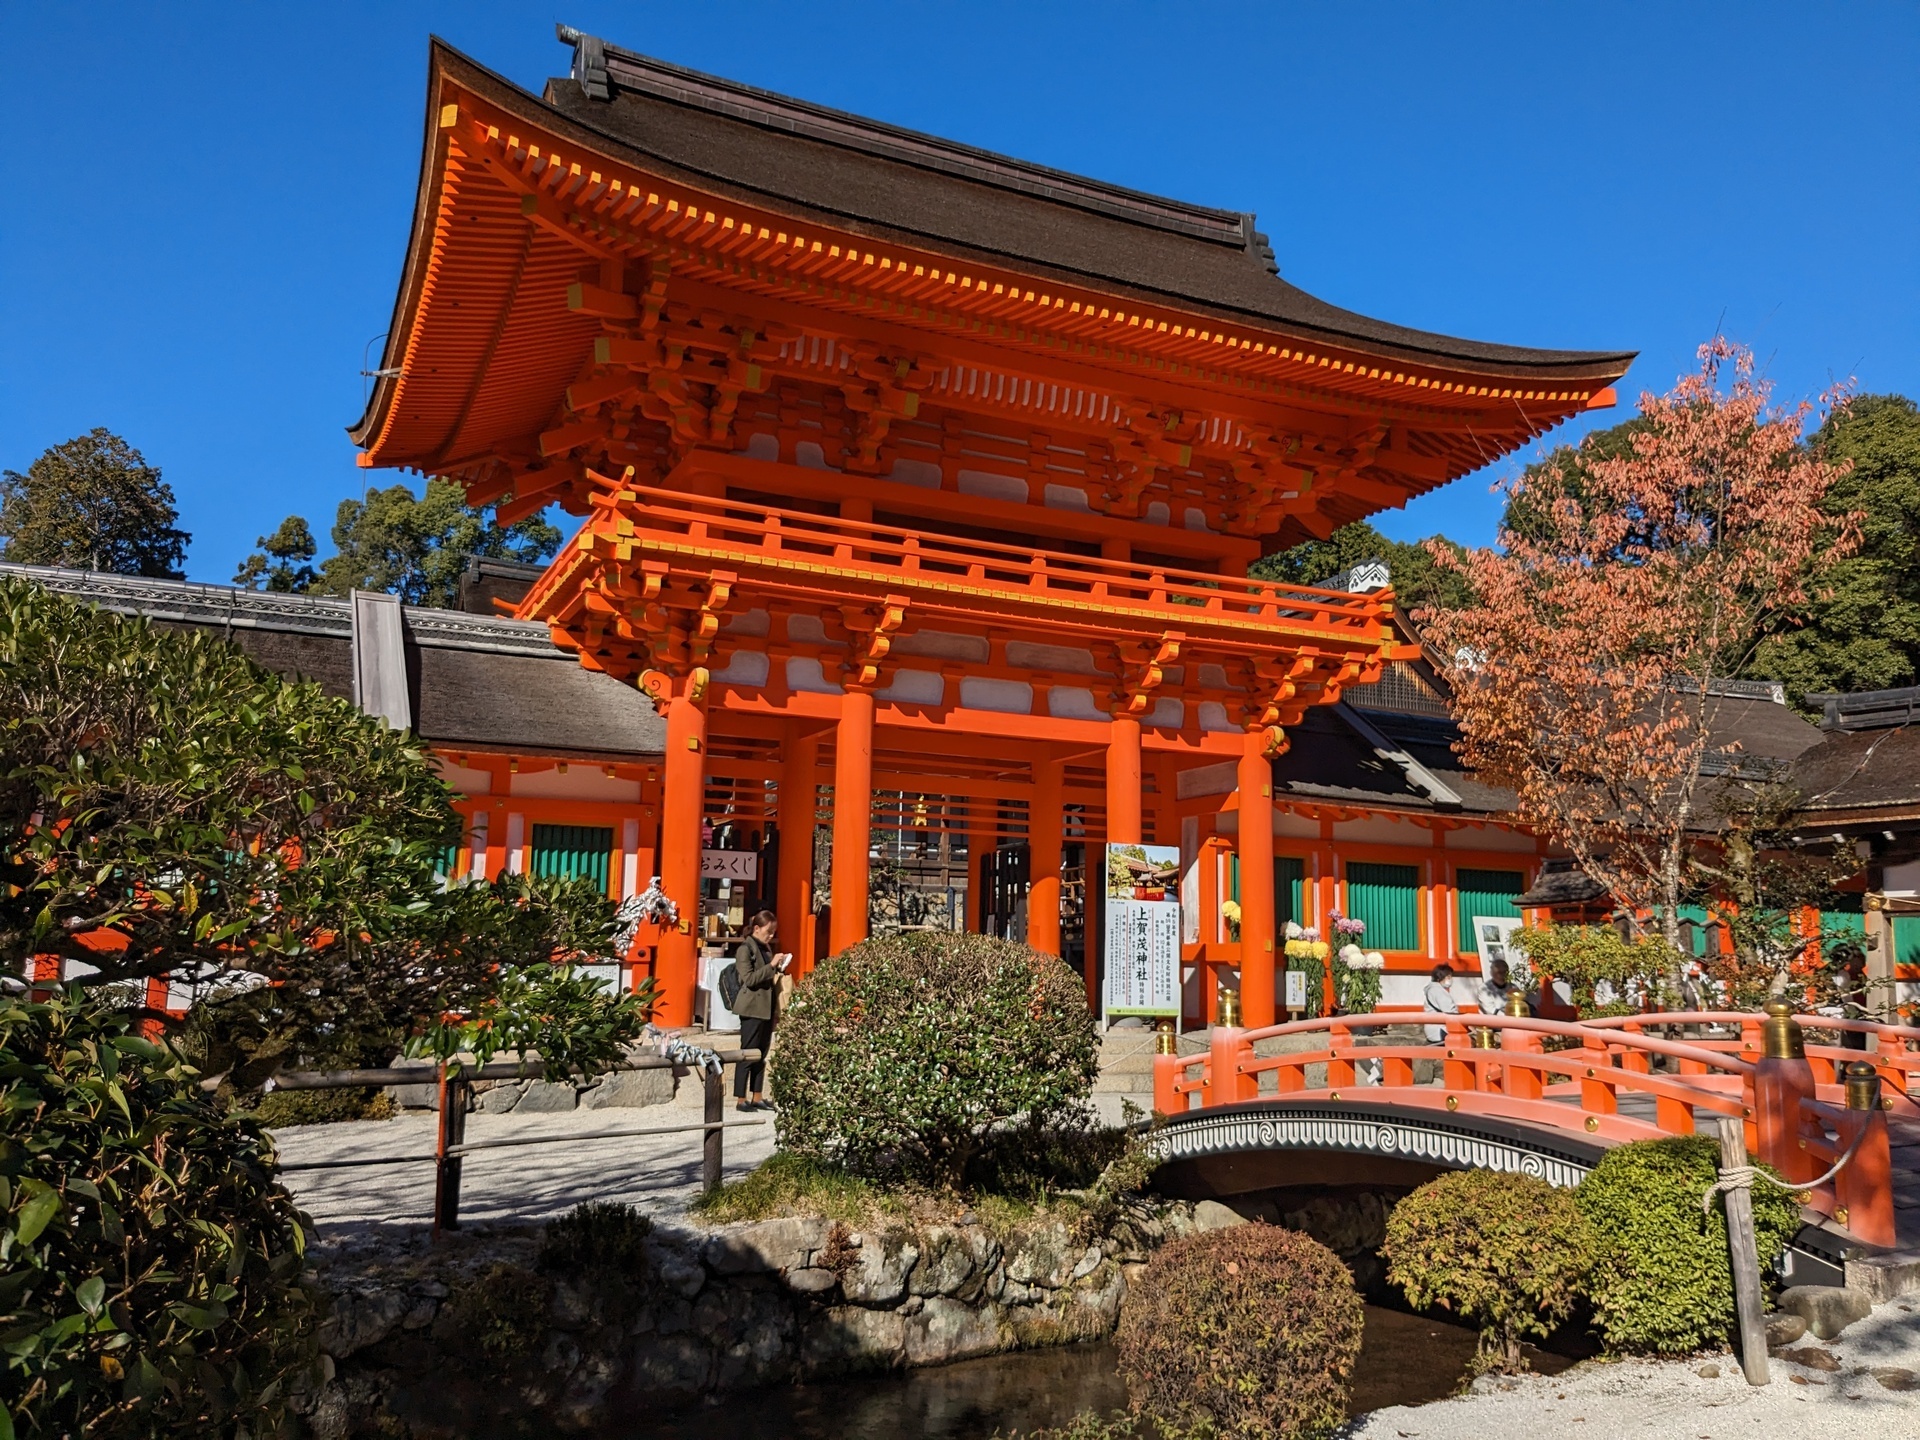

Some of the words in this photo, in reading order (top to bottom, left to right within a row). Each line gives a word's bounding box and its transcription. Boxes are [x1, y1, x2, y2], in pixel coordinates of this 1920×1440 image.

[702, 857, 752, 875] おみくじ
[1136, 906, 1148, 981] 上賀茂神社
